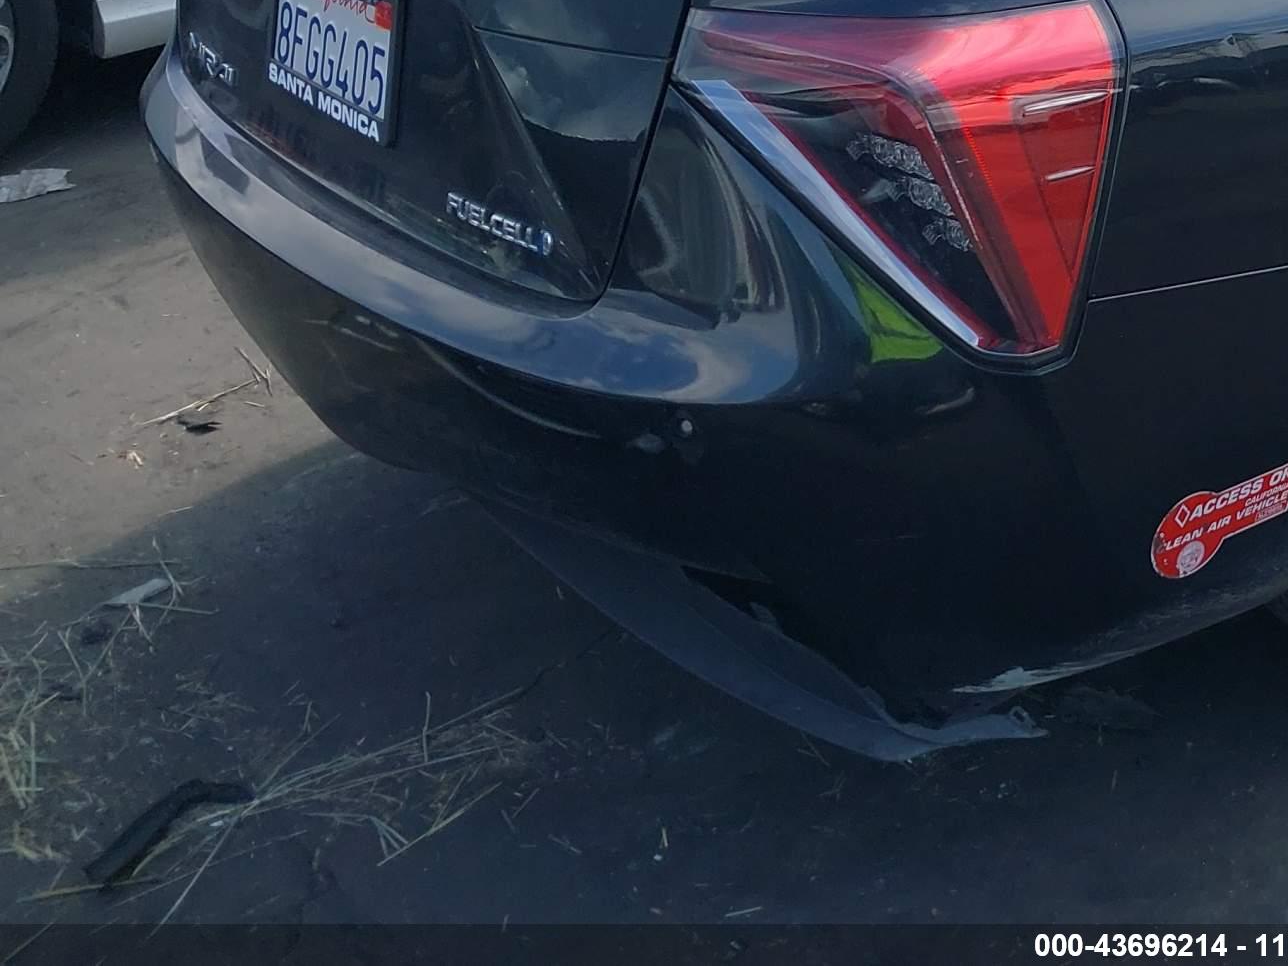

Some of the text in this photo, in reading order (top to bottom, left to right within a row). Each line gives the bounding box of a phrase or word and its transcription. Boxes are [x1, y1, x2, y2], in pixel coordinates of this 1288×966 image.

[277, 1, 386, 115] 8FGG405
[269, 62, 380, 143] SANTA MONICA
[1189, 479, 1264, 521] ACCESS
[1207, 515, 1233, 534] AIR
